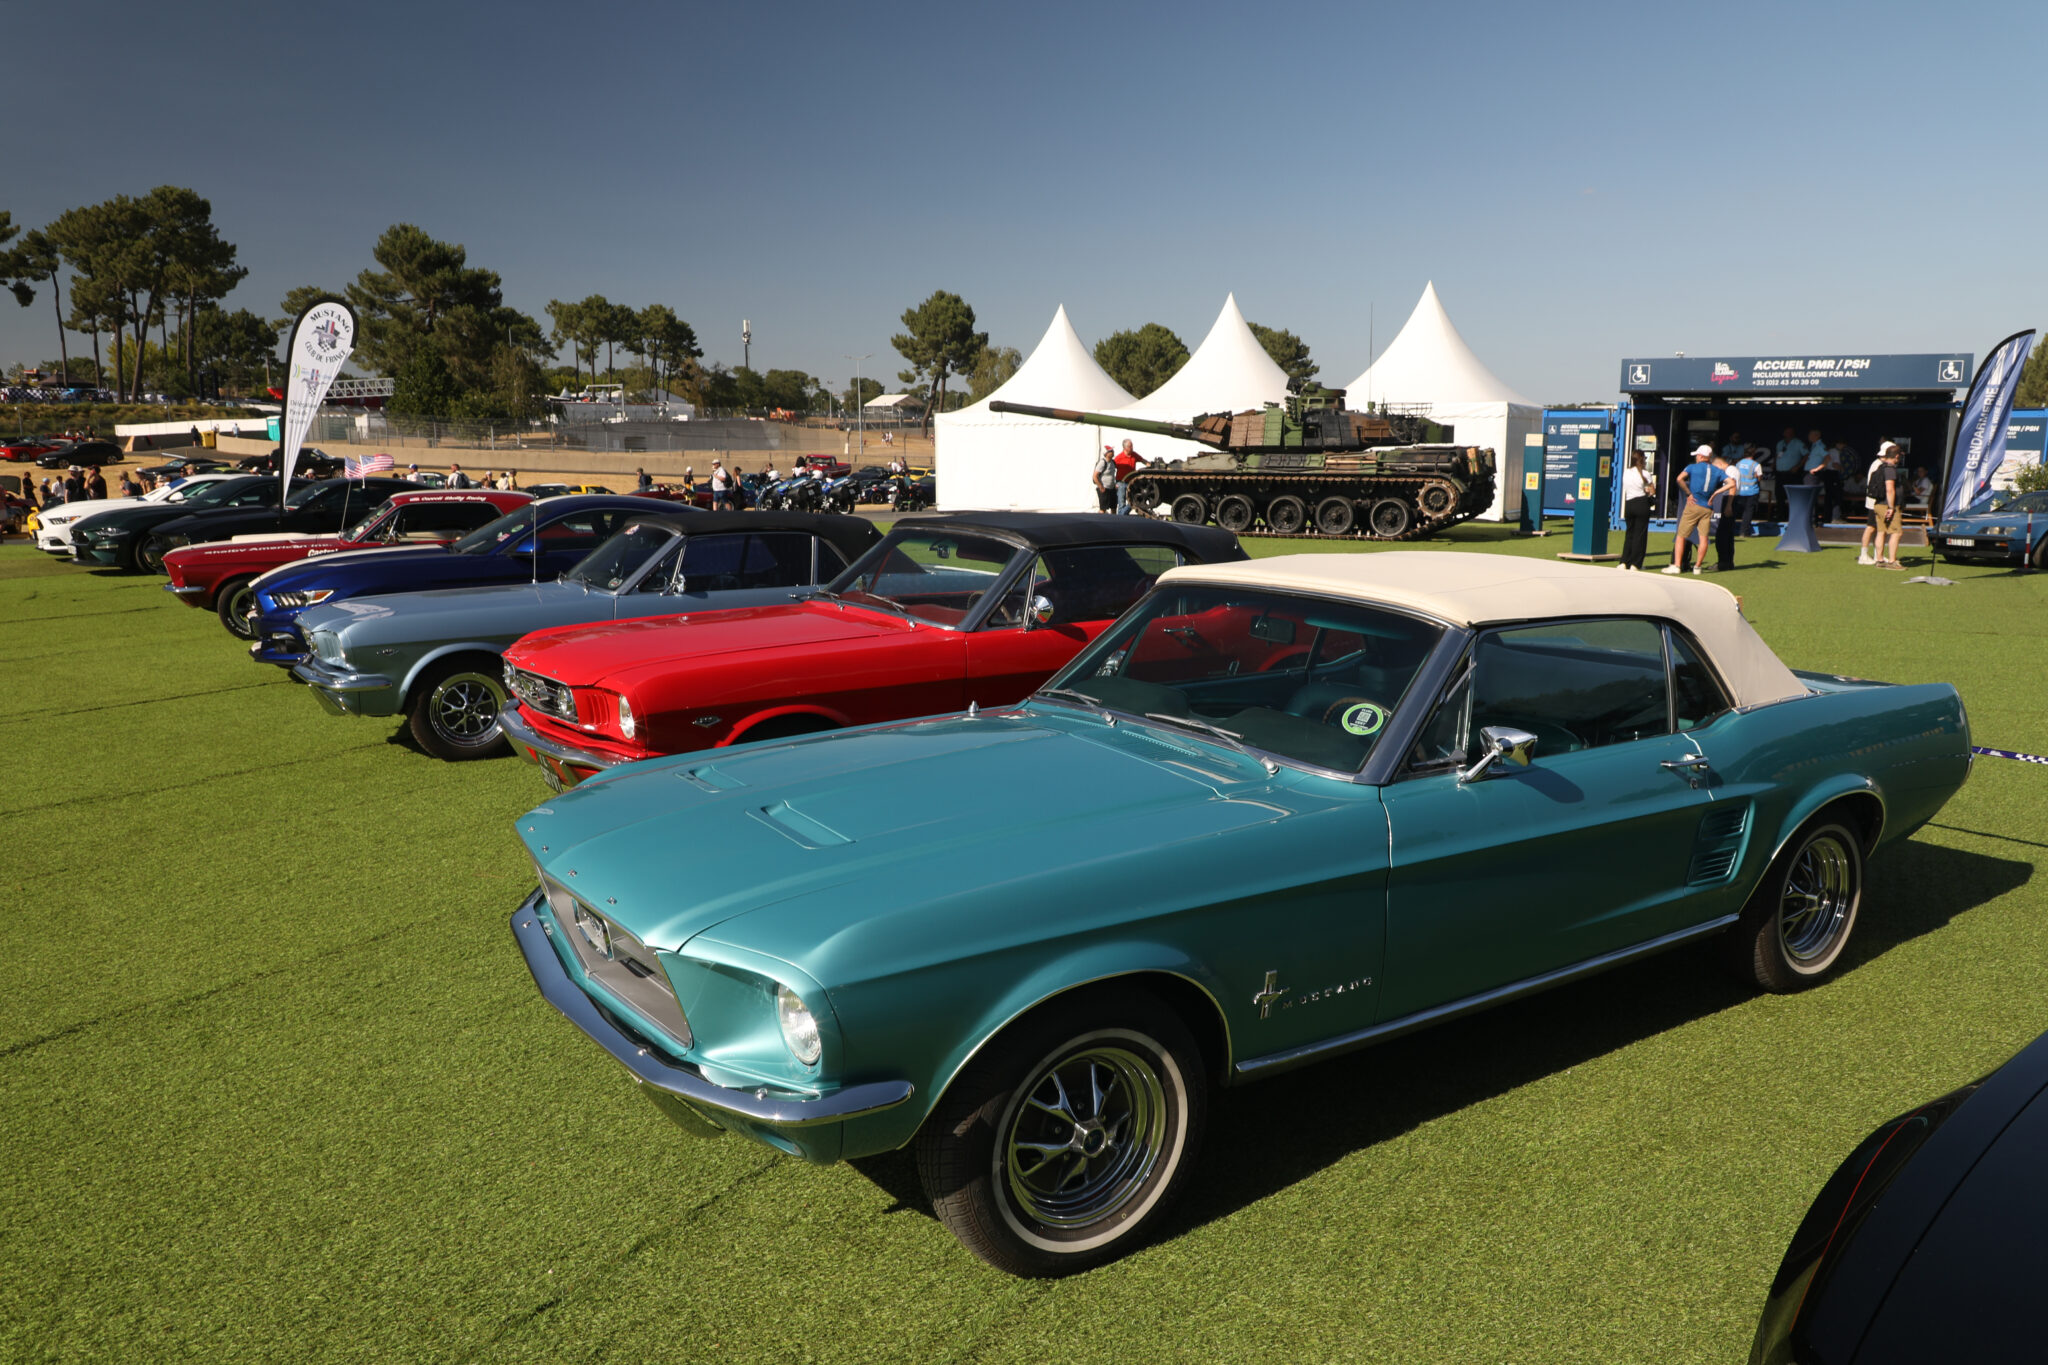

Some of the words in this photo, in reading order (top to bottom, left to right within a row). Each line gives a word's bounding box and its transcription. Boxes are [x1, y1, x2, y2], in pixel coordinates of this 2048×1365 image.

[310, 309, 351, 333] MUSTANG
[1754, 360, 1805, 370] ACCUEIL
[1807, 360, 1836, 370] PMR
[1836, 359, 1844, 370] /
[1844, 359, 1870, 369] PSH
[1966, 386, 2000, 470] GENDARMERIE
[1283, 976, 1372, 1009] MUSTANG
